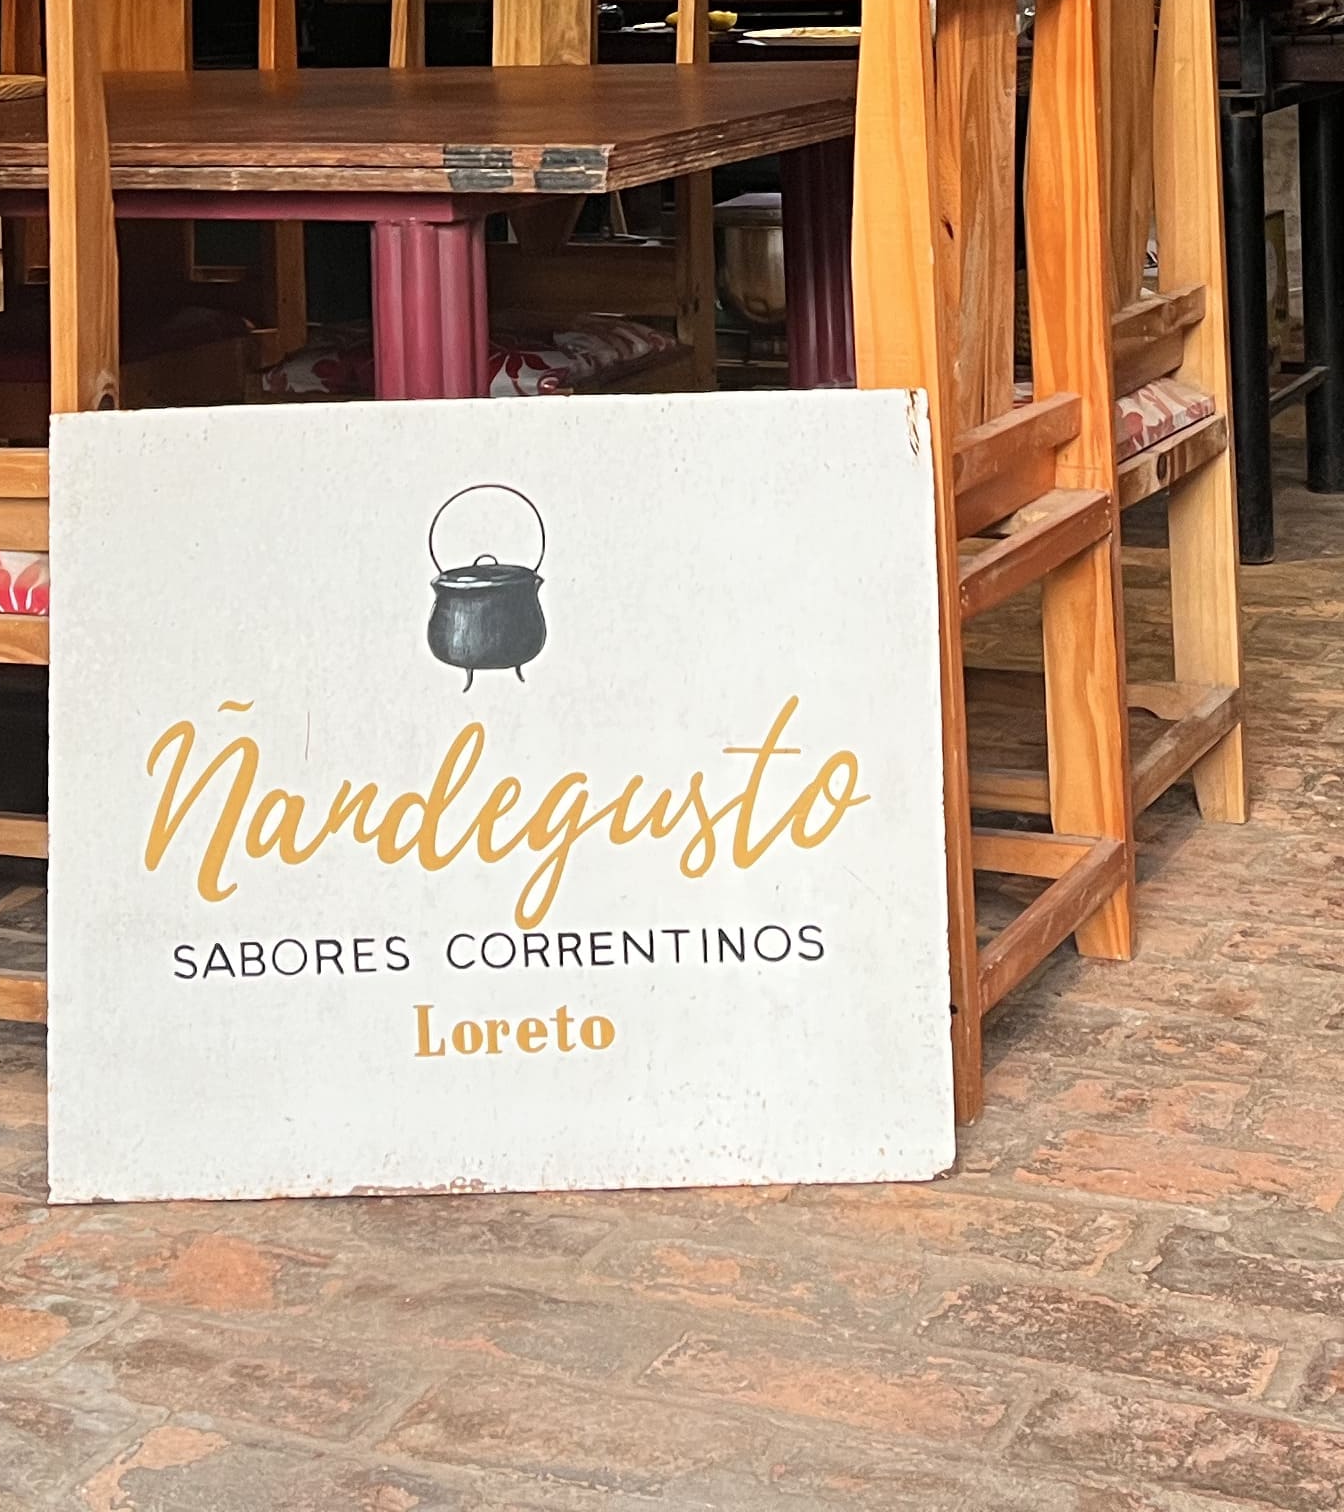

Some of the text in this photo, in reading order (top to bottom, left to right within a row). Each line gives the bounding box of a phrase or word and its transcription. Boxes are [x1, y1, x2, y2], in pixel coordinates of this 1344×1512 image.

[144, 695, 870, 931] Ñandegusto
[173, 925, 825, 979] SABORES CORRENTINOS
[413, 1004, 616, 1058] Loreto
